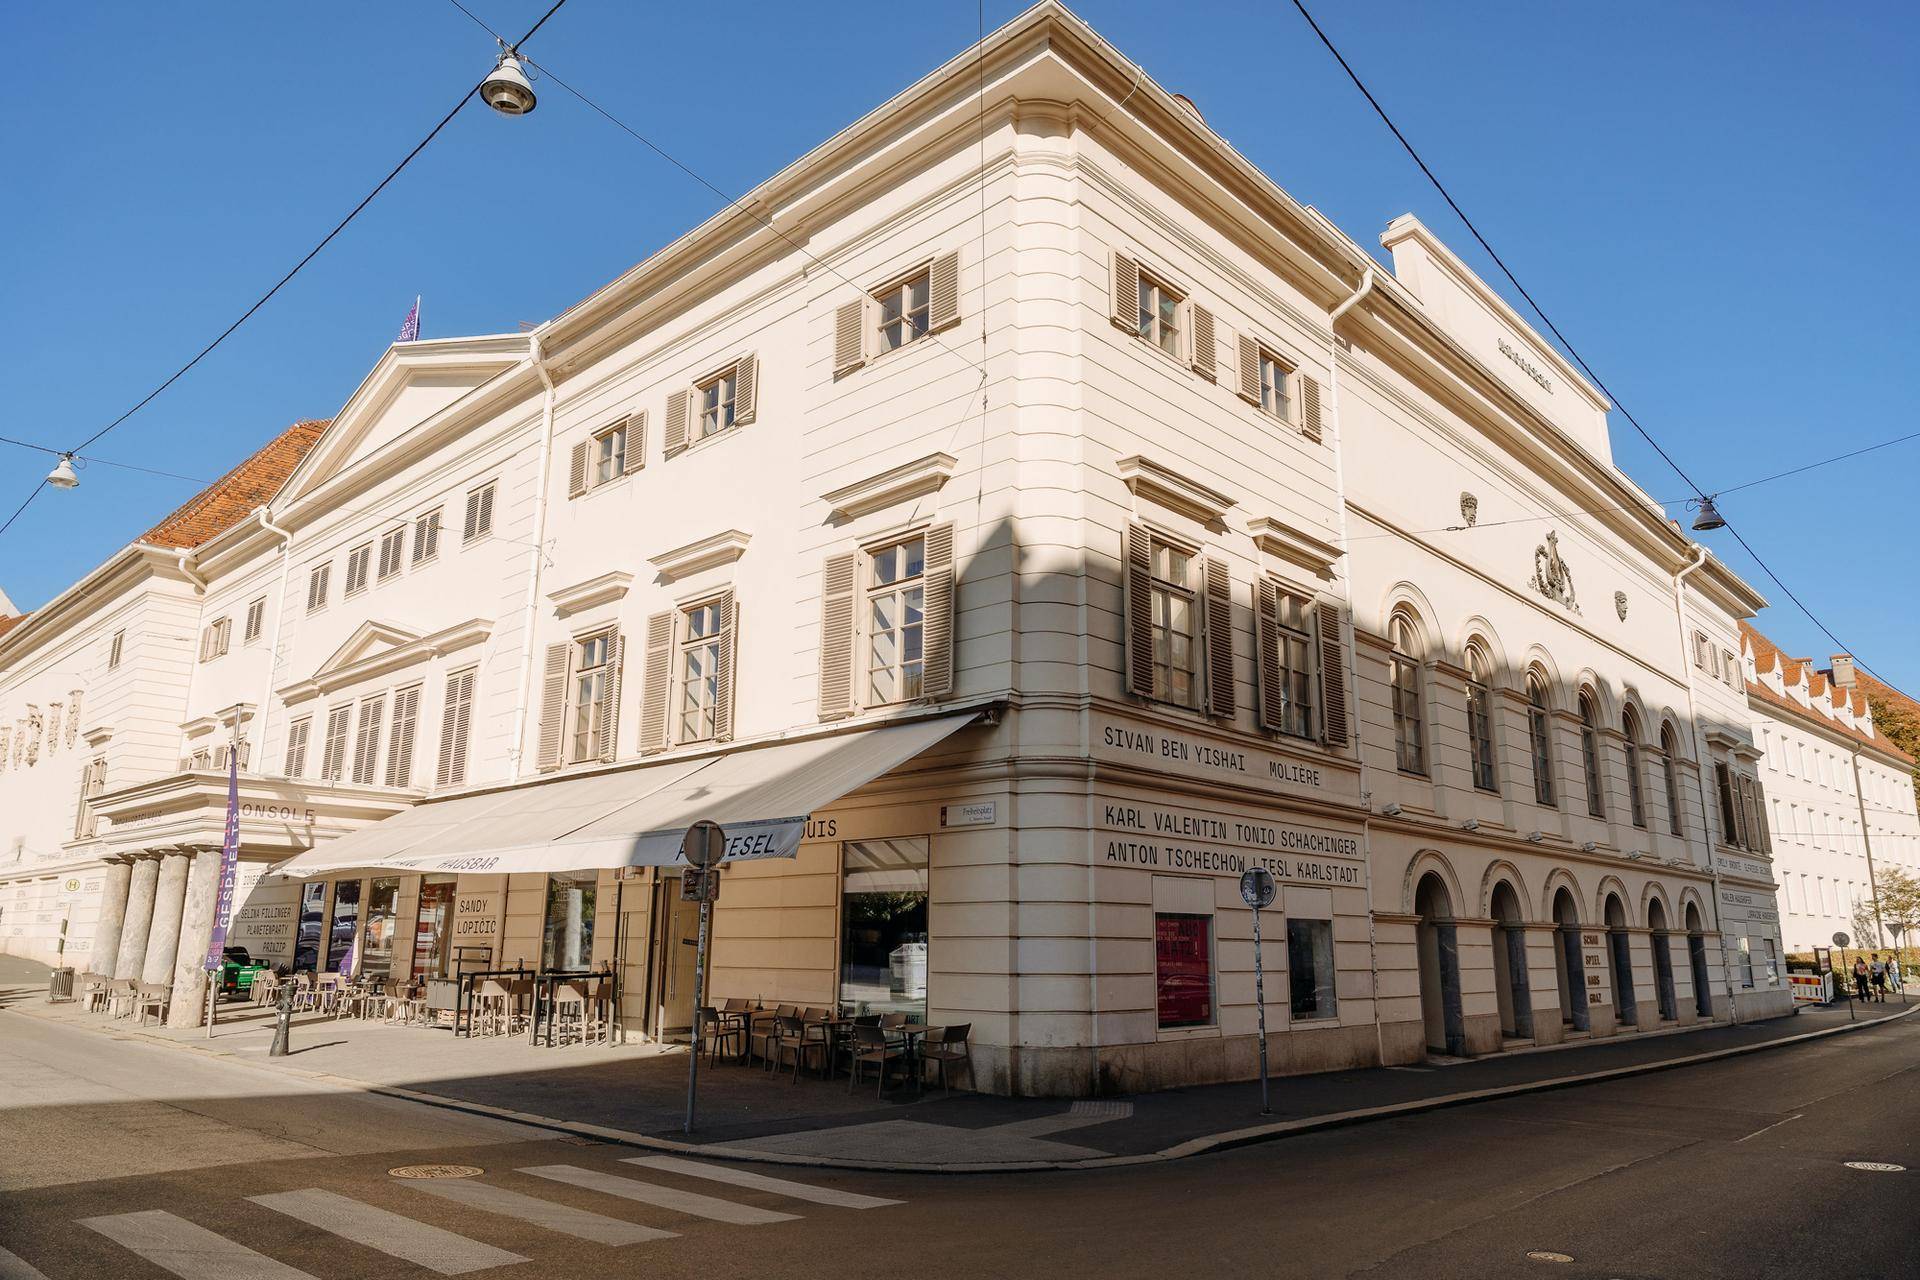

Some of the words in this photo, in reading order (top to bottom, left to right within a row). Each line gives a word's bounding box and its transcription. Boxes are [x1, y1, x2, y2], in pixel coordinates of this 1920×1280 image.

[1104, 726, 1154, 755] SIVAN
[1161, 739, 1189, 761] BEN
[1194, 746, 1246, 772] YISHAI
[1269, 761, 1320, 787] MOLIÈRE
[242, 803, 316, 826] ONSOLE
[801, 819, 838, 839] UIS
[1105, 804, 1146, 829] KARL
[1154, 811, 1227, 840] VALENTIN
[1235, 824, 1275, 846] TONIO
[1281, 830, 1358, 856] SCHACHINGER
[437, 856, 499, 870] HAUSBAR
[1107, 841, 1158, 865] ANTON
[1165, 847, 1246, 873] TSCHECHOW
[1297, 862, 1359, 884] KARLSTADT
[240, 907, 260, 919] SELINA
[261, 906, 291, 919] FILLINGER
[459, 899, 488, 913] SANDY
[246, 923, 288, 936] PLANETENPARTY
[262, 940, 286, 953] PRINZIP
[1583, 934, 1599, 946] SCHAU
[1585, 954, 1601, 966] SPIEL
[1587, 975, 1600, 986] HAUS
[1589, 993, 1602, 1004] GRAZ
